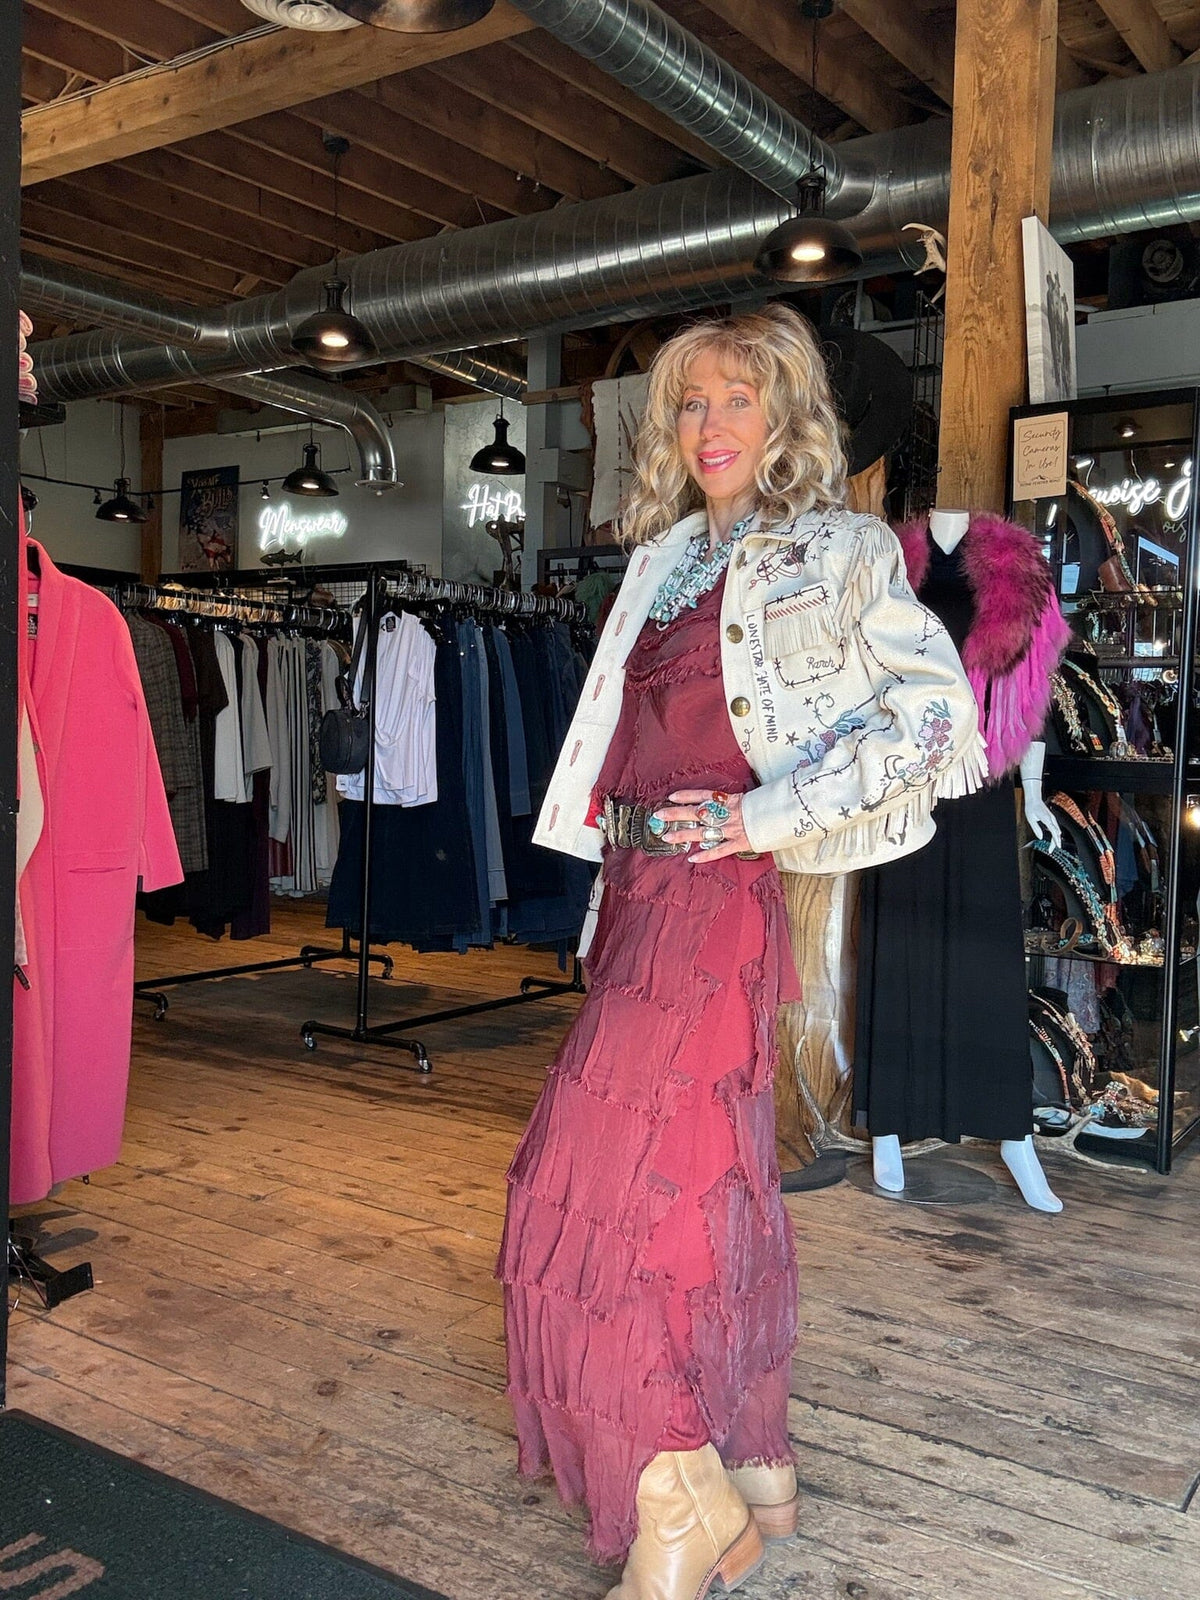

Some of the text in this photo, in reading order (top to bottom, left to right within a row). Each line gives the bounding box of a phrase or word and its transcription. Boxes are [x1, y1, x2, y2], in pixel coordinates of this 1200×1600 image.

[1021, 426, 1062, 443] Security
[1023, 444, 1060, 457] Cameras
[1025, 459, 1036, 472] In
[460, 484, 508, 528] Hat
[259, 503, 347, 550] Menswear
[806, 656, 835, 669] Ranch
[762, 699, 774, 713] OF
[764, 715, 778, 743] MIND
